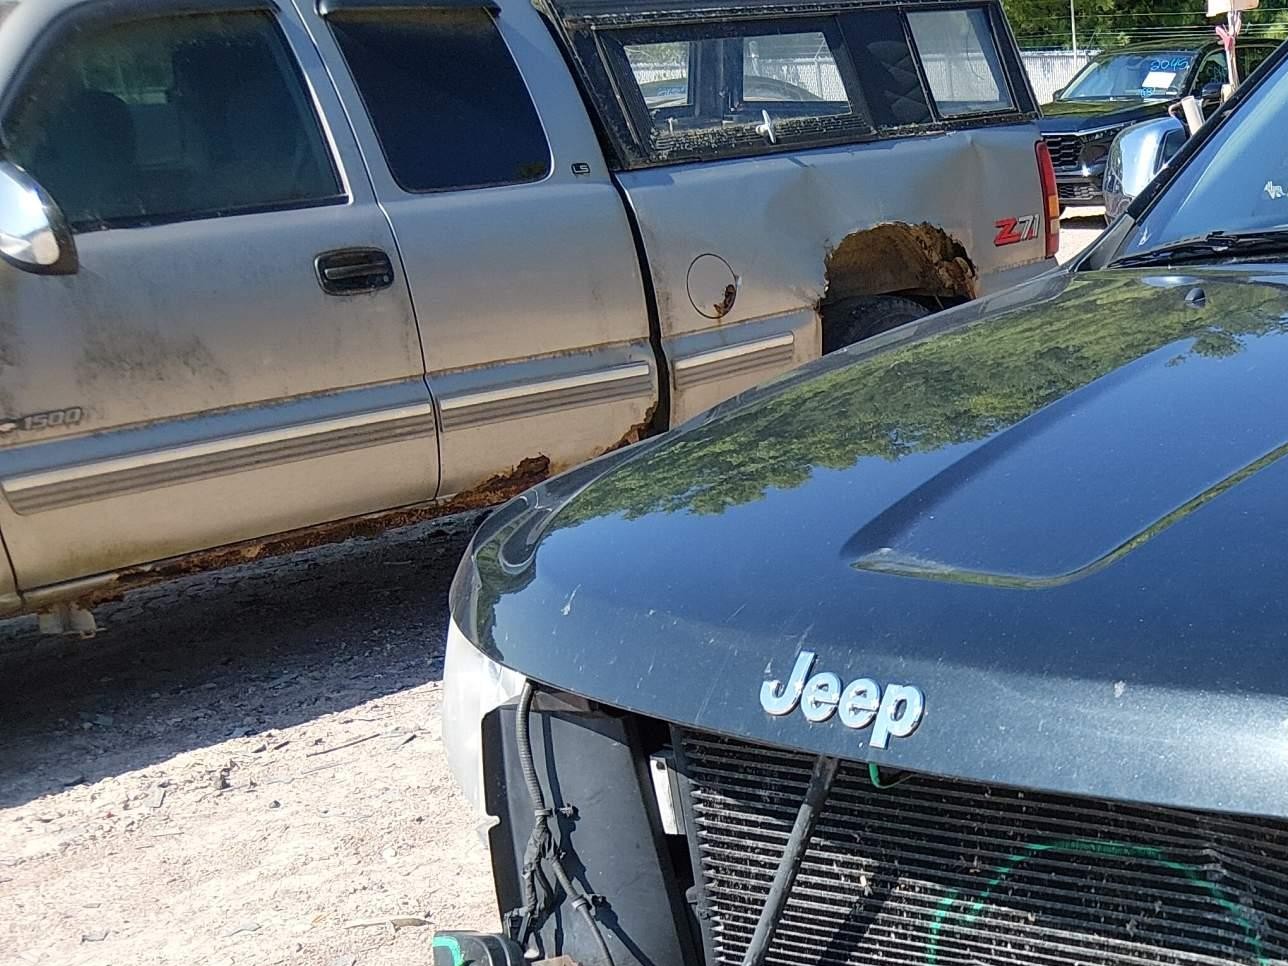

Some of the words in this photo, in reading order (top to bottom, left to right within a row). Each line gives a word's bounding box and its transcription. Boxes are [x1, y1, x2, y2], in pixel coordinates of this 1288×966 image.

[572, 164, 590, 173] LS
[994, 214, 1039, 246] Z71
[23, 408, 81, 430] 1500
[760, 650, 926, 750] Jeep
